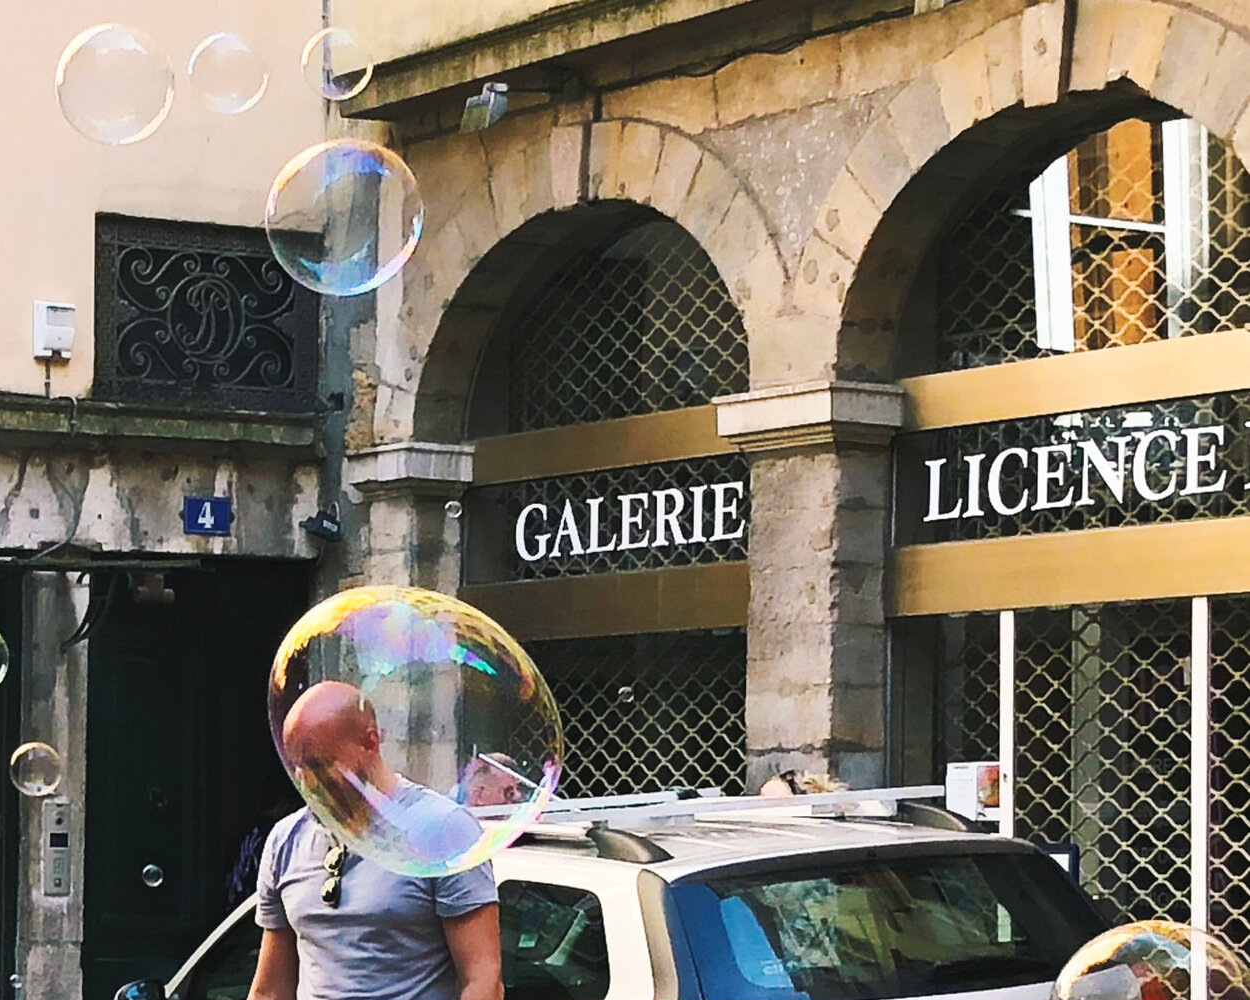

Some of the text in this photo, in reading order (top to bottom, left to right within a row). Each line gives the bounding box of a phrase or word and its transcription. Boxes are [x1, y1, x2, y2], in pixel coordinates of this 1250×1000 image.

[923, 425, 1227, 522] LICENCE
[197, 501, 215, 529] 4
[515, 481, 746, 562] GALERIE
